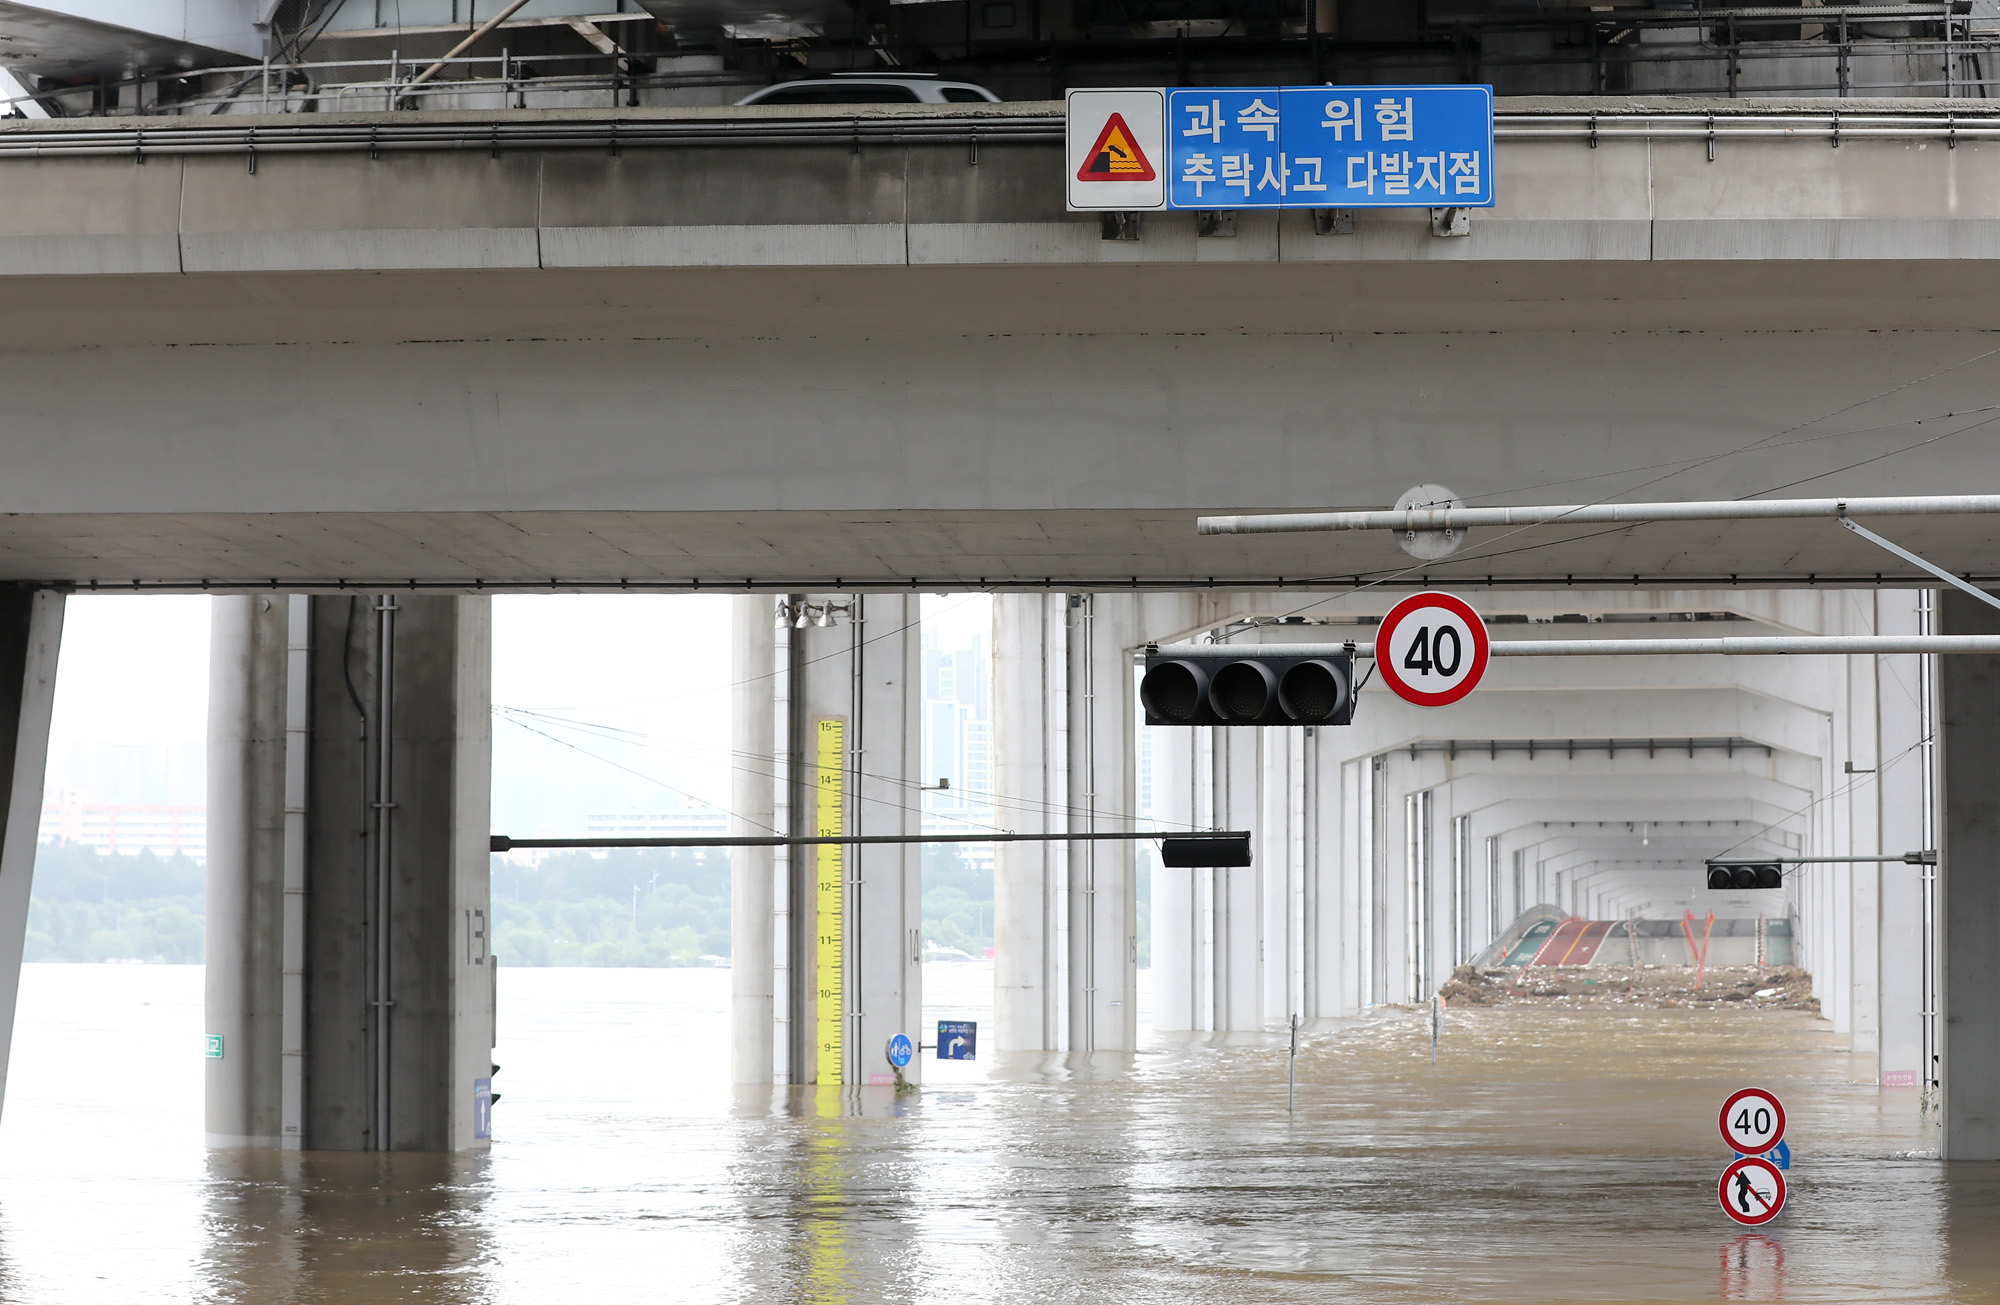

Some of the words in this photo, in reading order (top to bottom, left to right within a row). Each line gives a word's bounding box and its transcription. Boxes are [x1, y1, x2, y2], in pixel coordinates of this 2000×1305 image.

[1182, 97, 1279, 143] 과속
[1321, 96, 1414, 141] 위험
[1182, 152, 1327, 198] 추락사고
[1346, 150, 1481, 196] 다발지점
[1404, 625, 1461, 677] 40
[821, 722, 832, 732] 15
[820, 775, 831, 785] 14
[820, 829, 832, 838] 13
[820, 882, 831, 892] 12
[465, 909, 485, 966] 13
[820, 936, 832, 945] 11
[820, 989, 831, 999] 10
[824, 1043, 831, 1052] 9
[1734, 1107, 1771, 1135] 40
